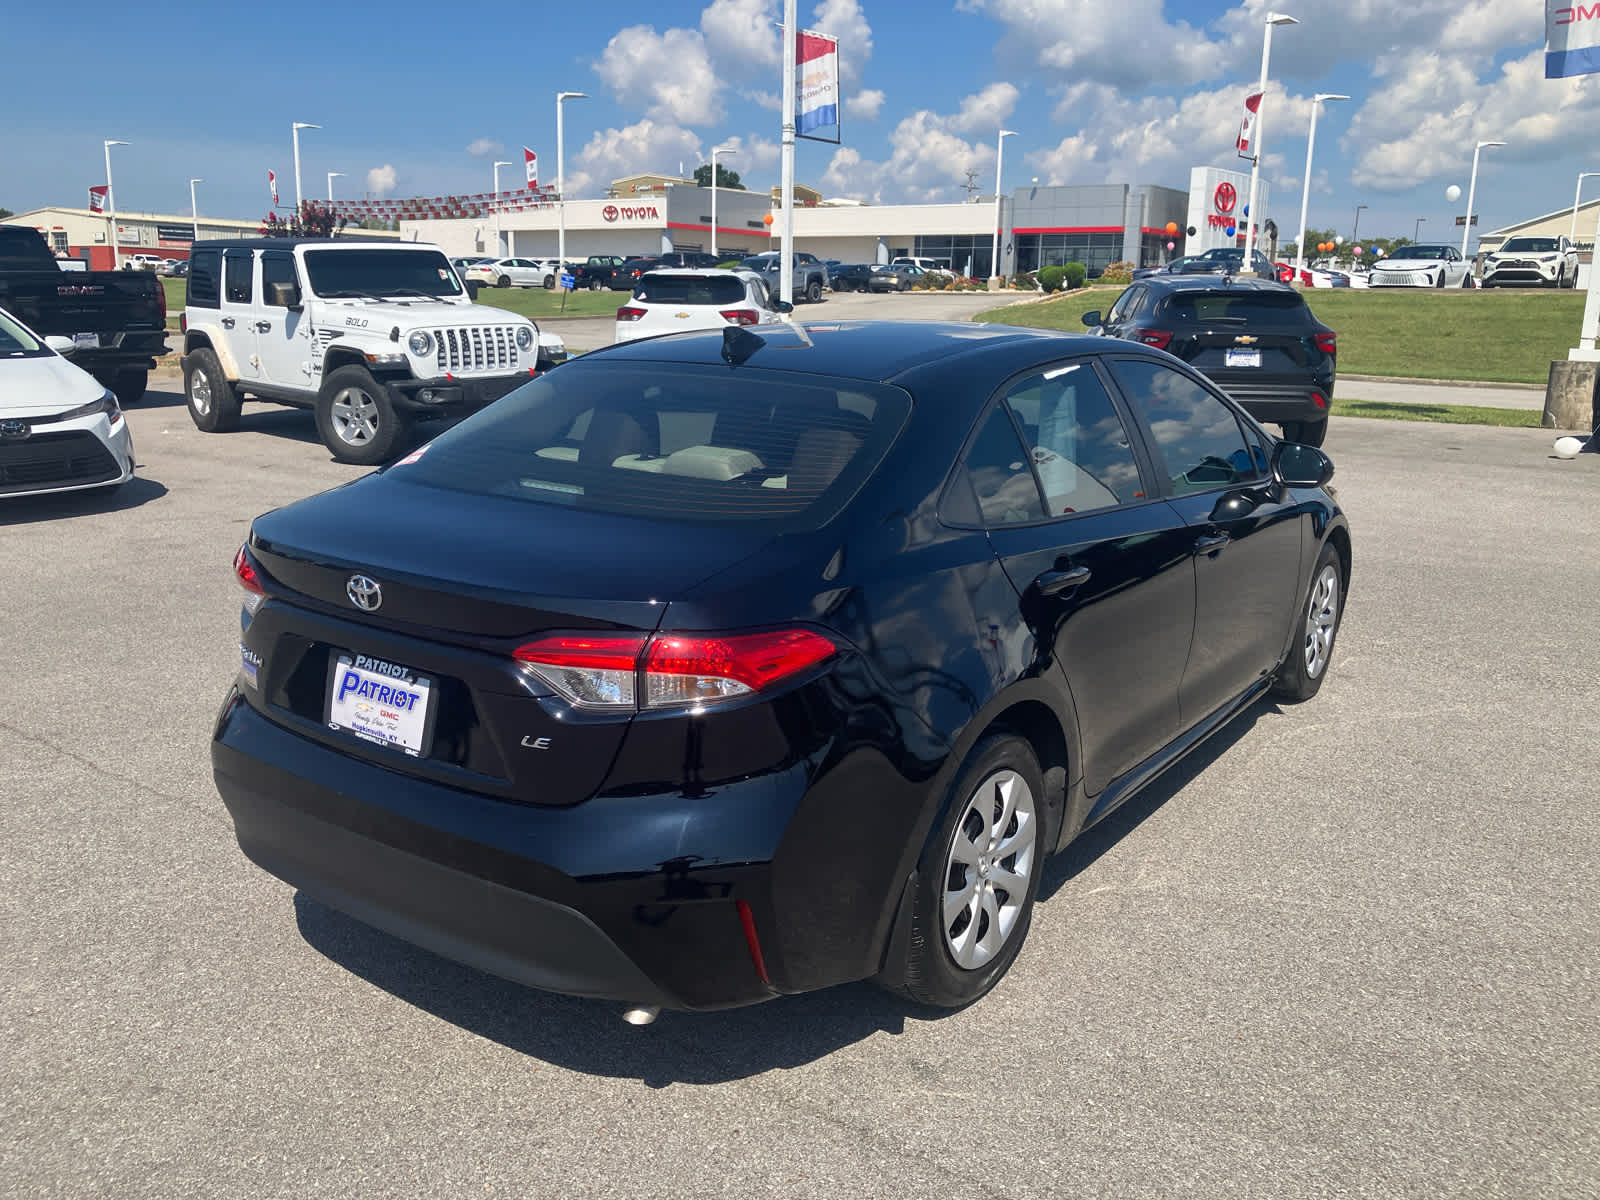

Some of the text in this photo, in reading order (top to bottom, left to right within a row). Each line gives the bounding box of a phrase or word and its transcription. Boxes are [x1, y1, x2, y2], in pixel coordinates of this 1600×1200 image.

[620, 206, 659, 219] TOYOTA
[355, 654, 409, 678] PATRIOT
[338, 670, 420, 711] PATRIOT
[380, 709, 400, 721] GMC
[520, 735, 553, 750] LE
